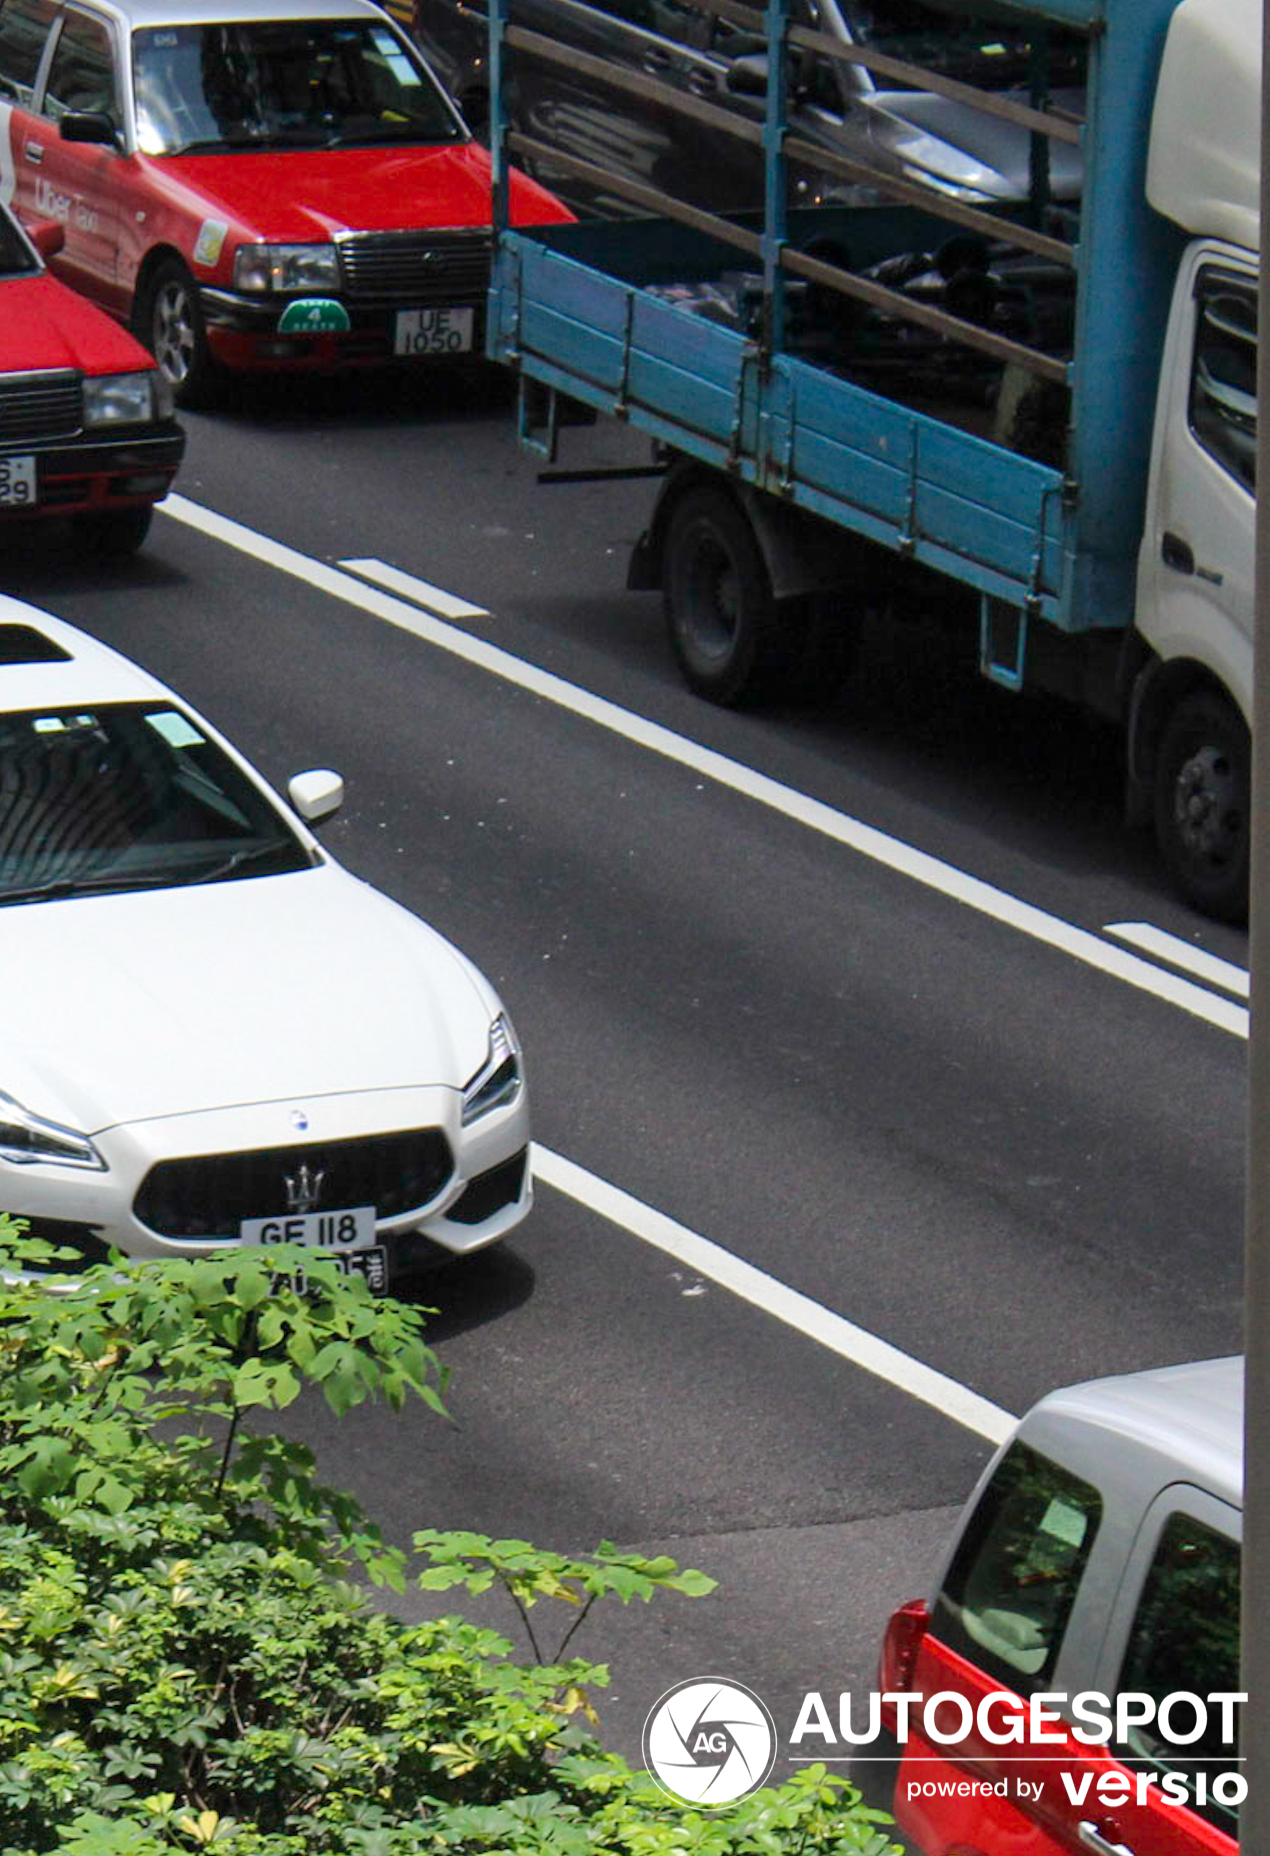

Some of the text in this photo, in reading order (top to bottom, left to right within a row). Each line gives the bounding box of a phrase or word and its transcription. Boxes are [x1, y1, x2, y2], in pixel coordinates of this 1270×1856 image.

[34, 177, 71, 222] Uber
[307, 308, 322, 322] 4
[419, 311, 451, 333] UE
[405, 330, 462, 354] 1050
[260, 1214, 358, 1247] GE 118
